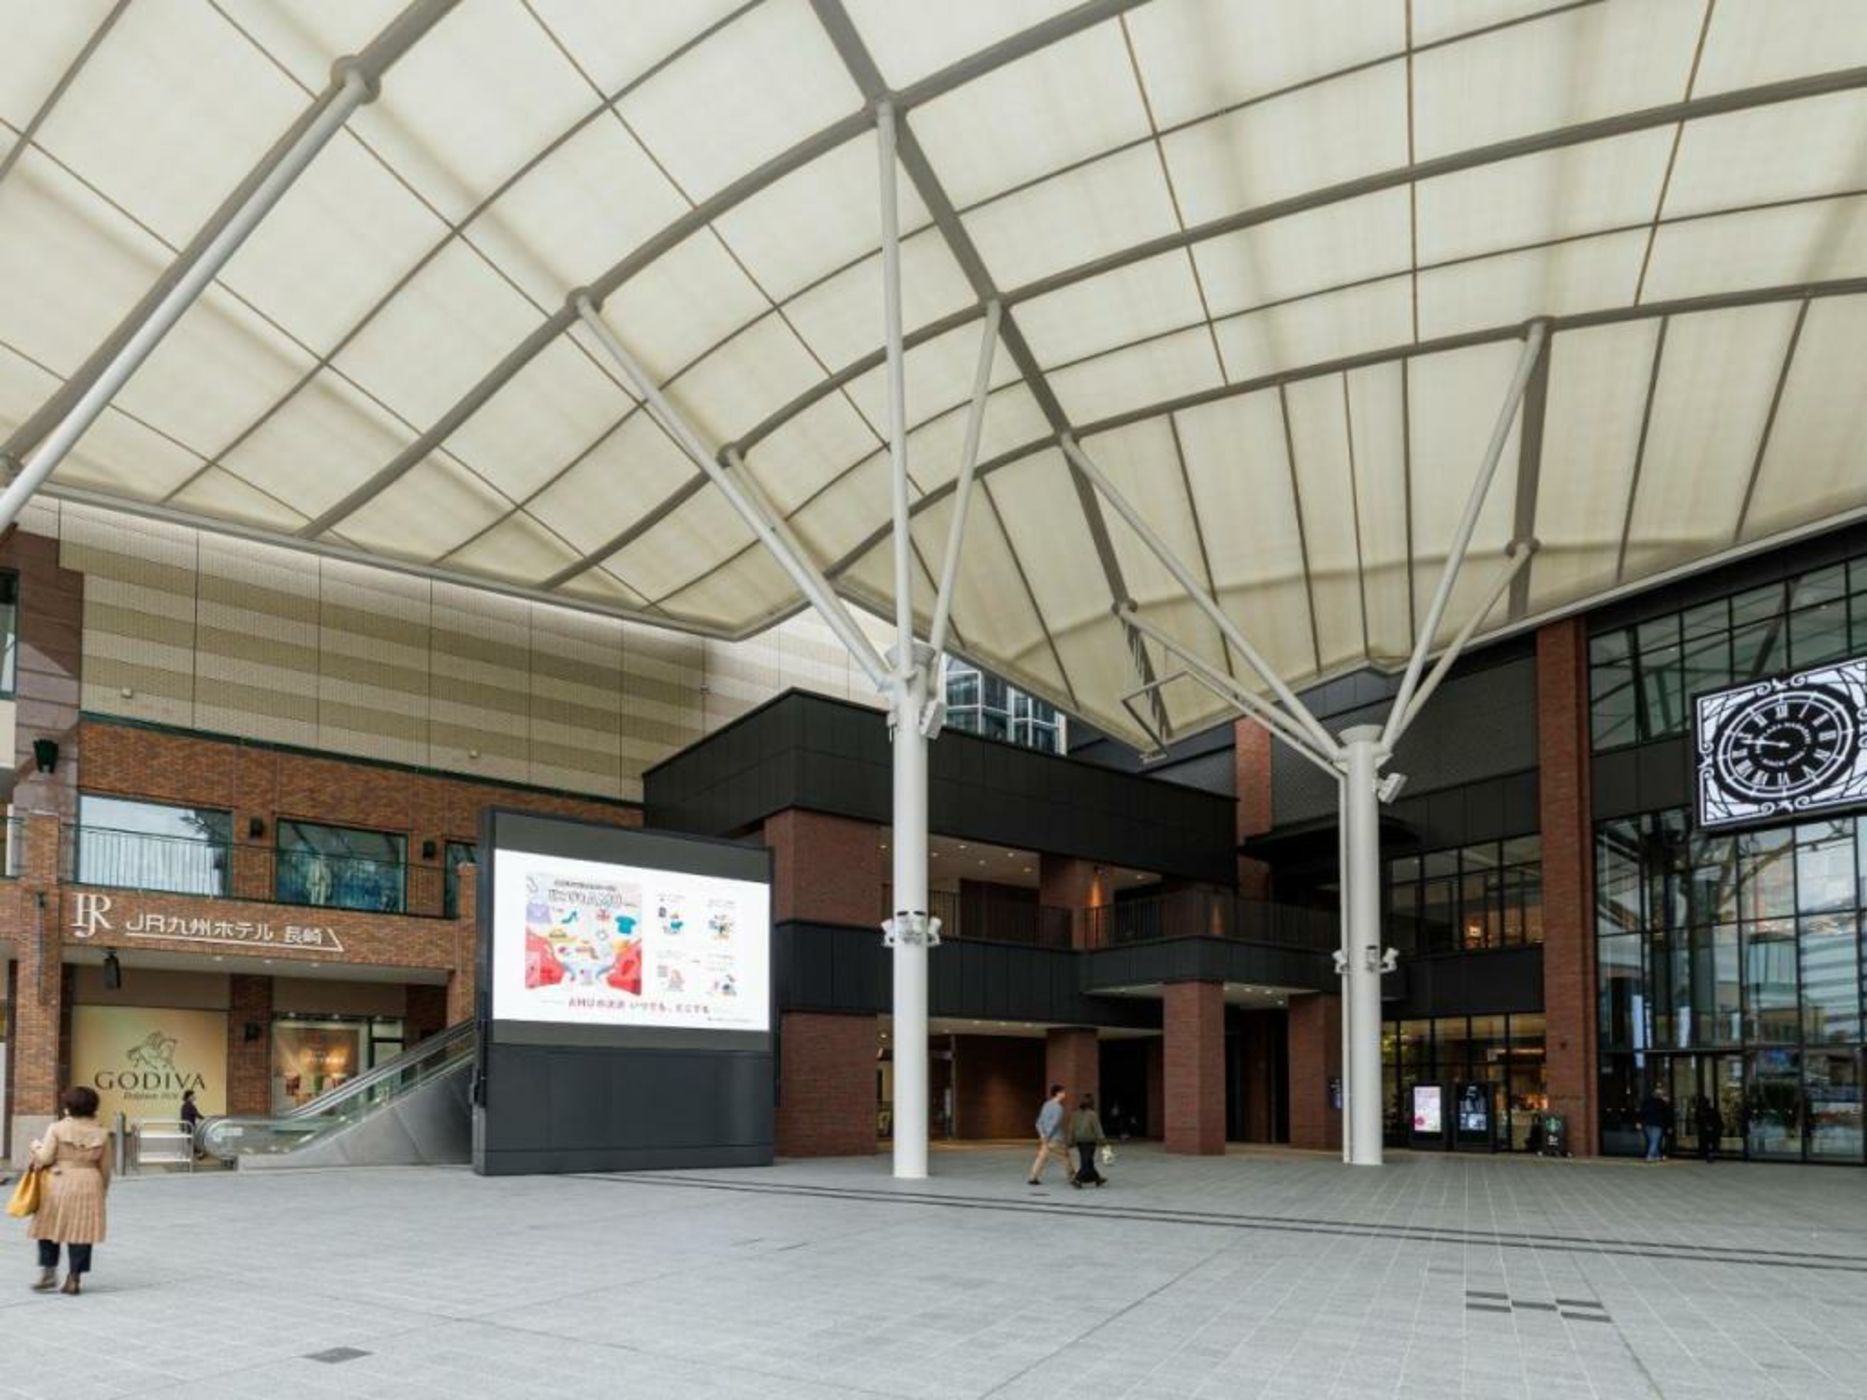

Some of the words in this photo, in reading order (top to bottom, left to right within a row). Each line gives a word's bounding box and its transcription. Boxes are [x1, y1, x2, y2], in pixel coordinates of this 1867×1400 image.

[126, 912, 274, 942] JR九州ホテル
[283, 925, 322, 945] 長崎
[94, 1071, 206, 1090] GODIVA
